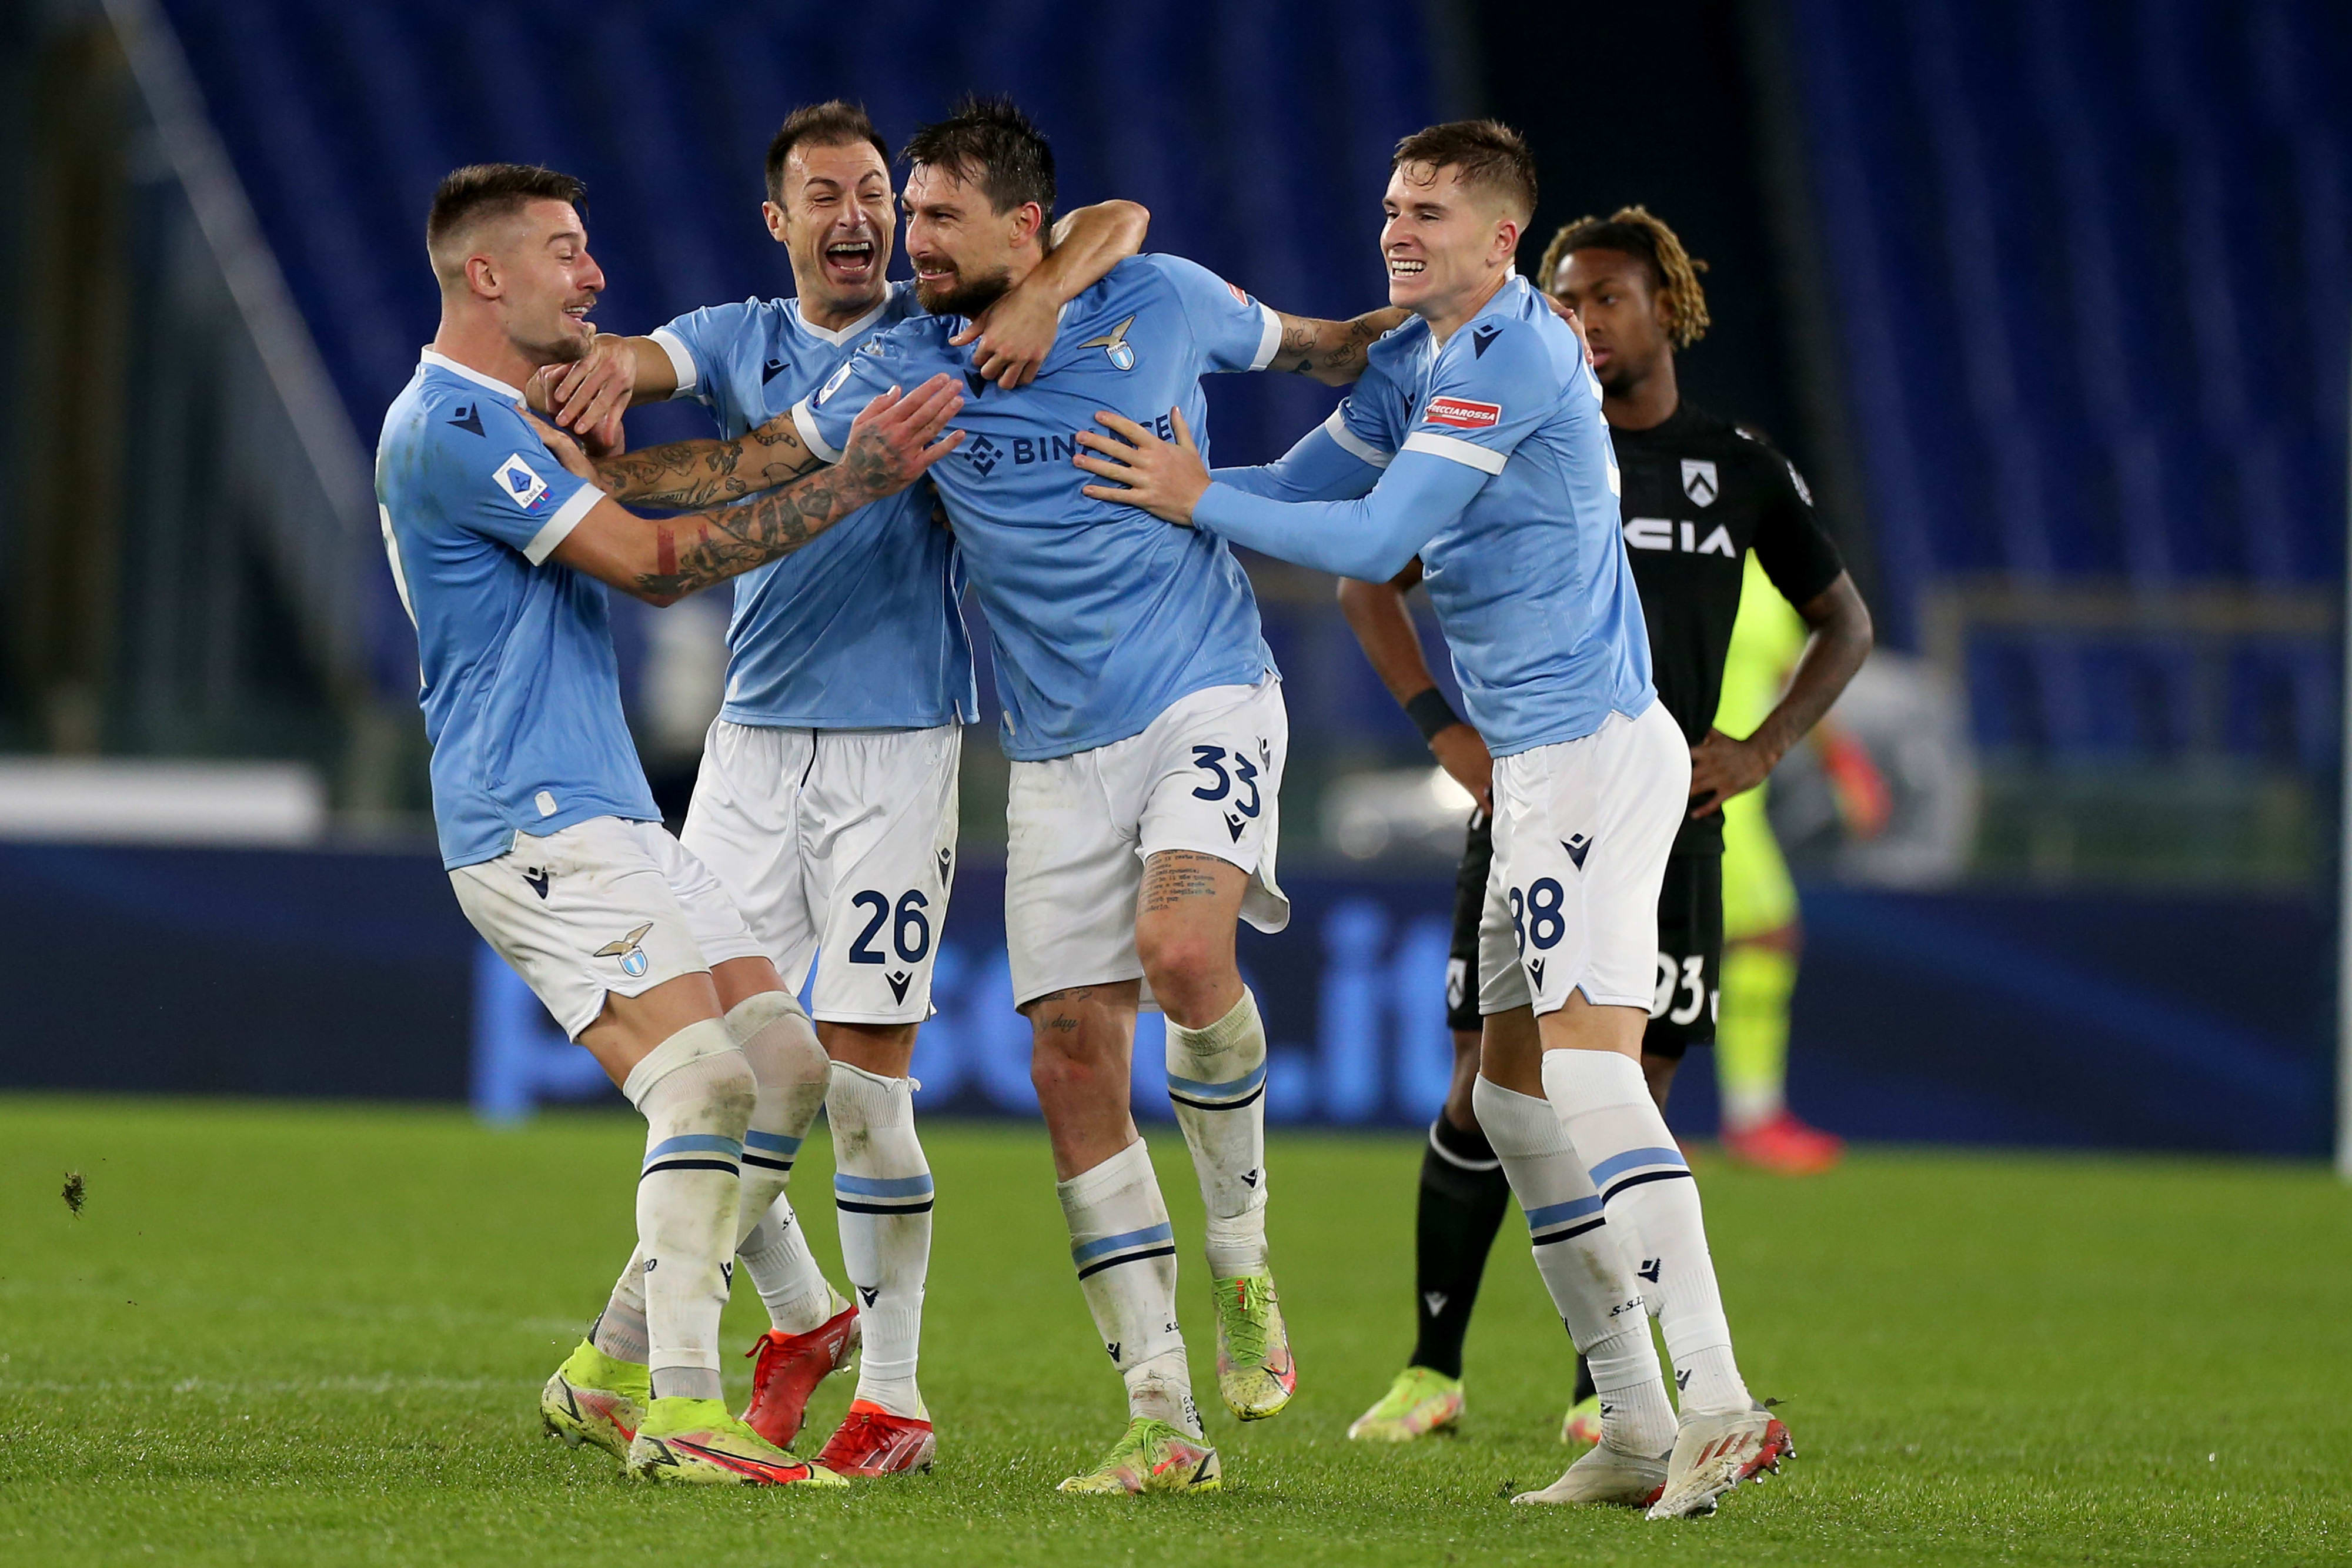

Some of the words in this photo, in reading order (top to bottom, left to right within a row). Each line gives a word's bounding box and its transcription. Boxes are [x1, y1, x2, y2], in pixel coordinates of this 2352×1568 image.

[522, 488, 539, 504] SERIE
[1192, 745, 1260, 818] 33
[849, 889, 930, 964] 26
